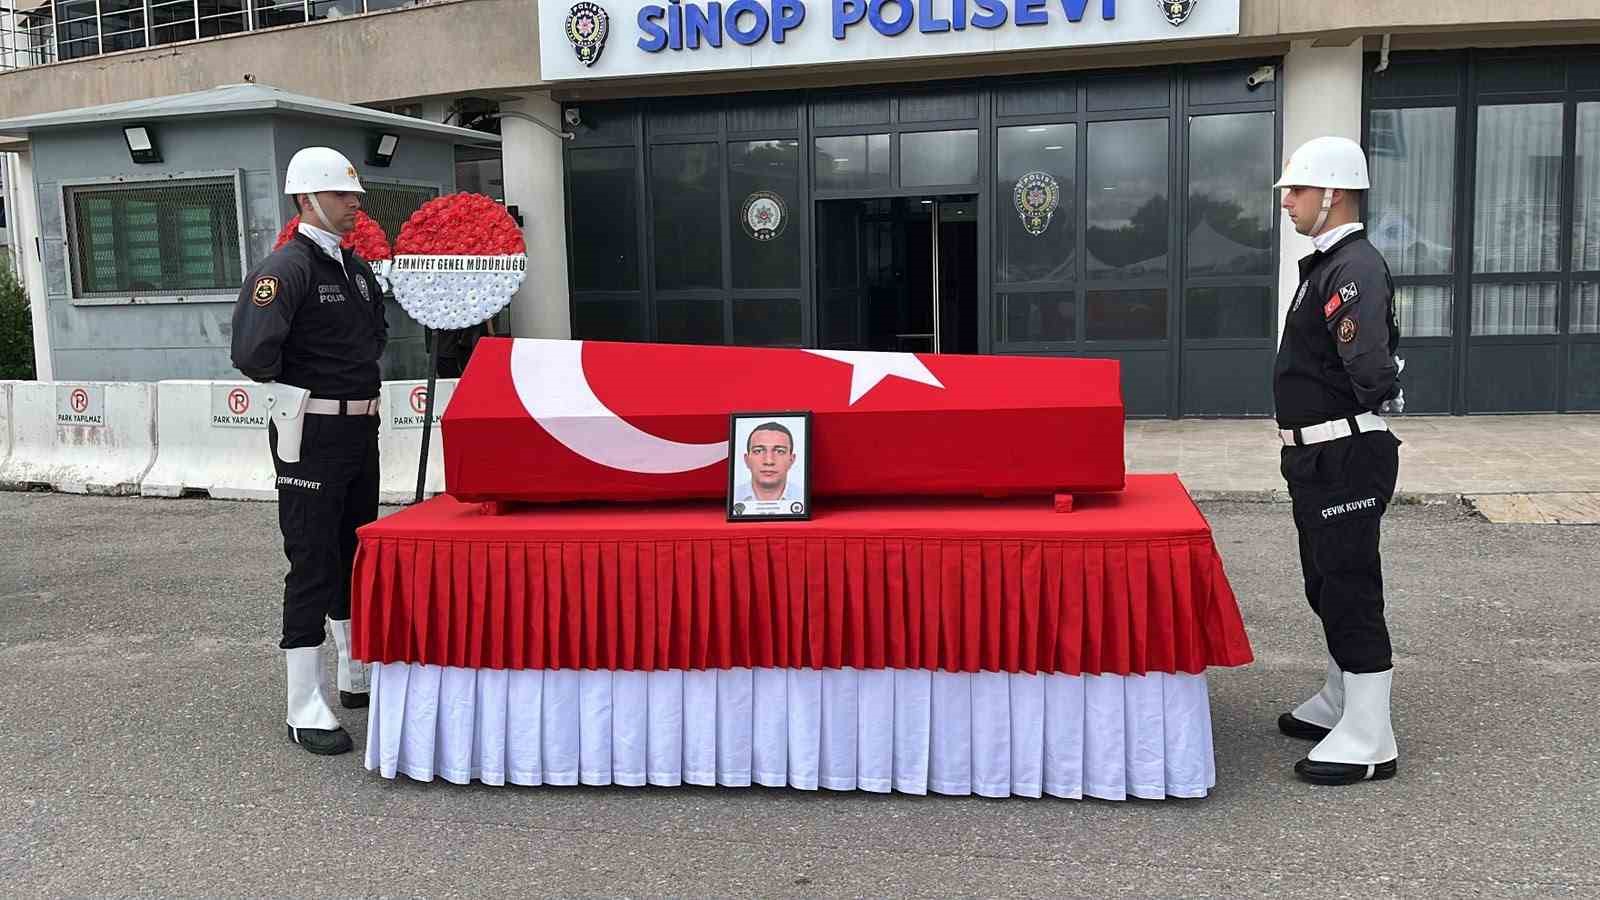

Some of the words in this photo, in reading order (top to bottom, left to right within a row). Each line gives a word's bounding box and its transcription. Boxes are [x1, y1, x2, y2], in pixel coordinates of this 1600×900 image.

[636, 0, 806, 52] SİNOP
[398, 256, 435, 270] EMNİYET
[437, 258, 464, 271] GENEL
[466, 256, 526, 271] MÜDÜRLÜĞÜ
[58, 414, 72, 422] PARK
[74, 415, 102, 423] YAPILMAZ
[213, 415, 231, 424] PARK
[232, 416, 264, 425] YAPILMAZ
[394, 416, 414, 425] PARK
[293, 478, 321, 490] KUVVET
[1345, 497, 1376, 512] KUVVET
